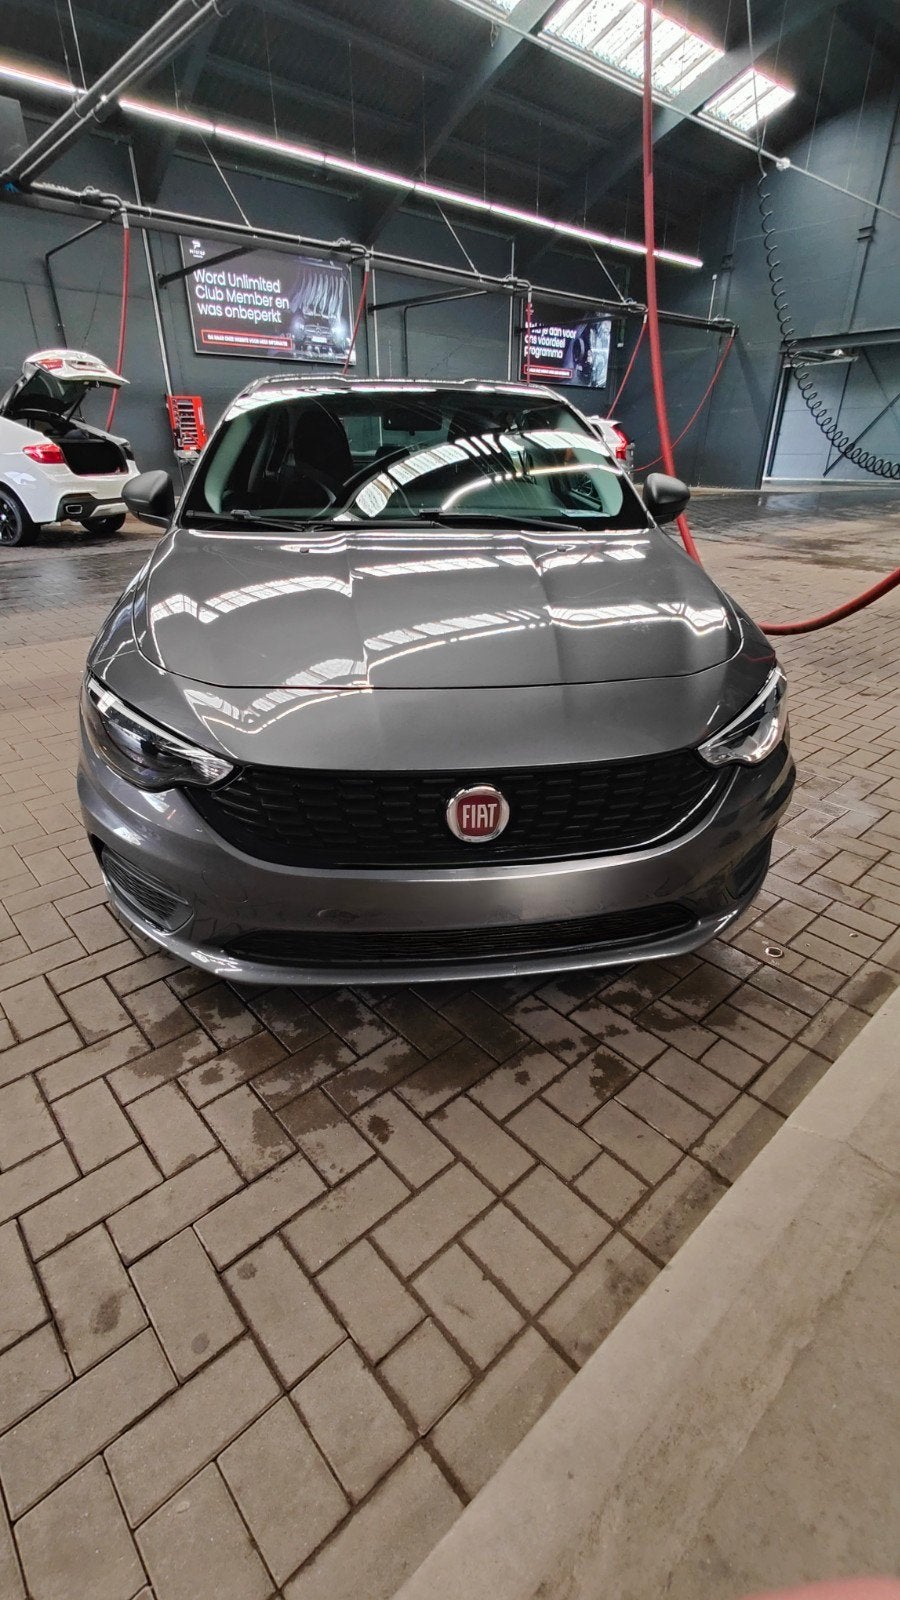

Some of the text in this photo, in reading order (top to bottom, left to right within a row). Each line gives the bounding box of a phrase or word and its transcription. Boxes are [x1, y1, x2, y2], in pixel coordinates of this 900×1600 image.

[193, 269, 281, 293] Word Unlimited
[195, 284, 290, 309] Club Member en
[197, 303, 282, 324] was onbeperkt
[538, 336, 566, 348] voordeel
[549, 327, 562, 337] aan
[563, 329, 577, 339] voor
[523, 346, 563, 359] programma
[462, 803, 498, 829] FIAT
